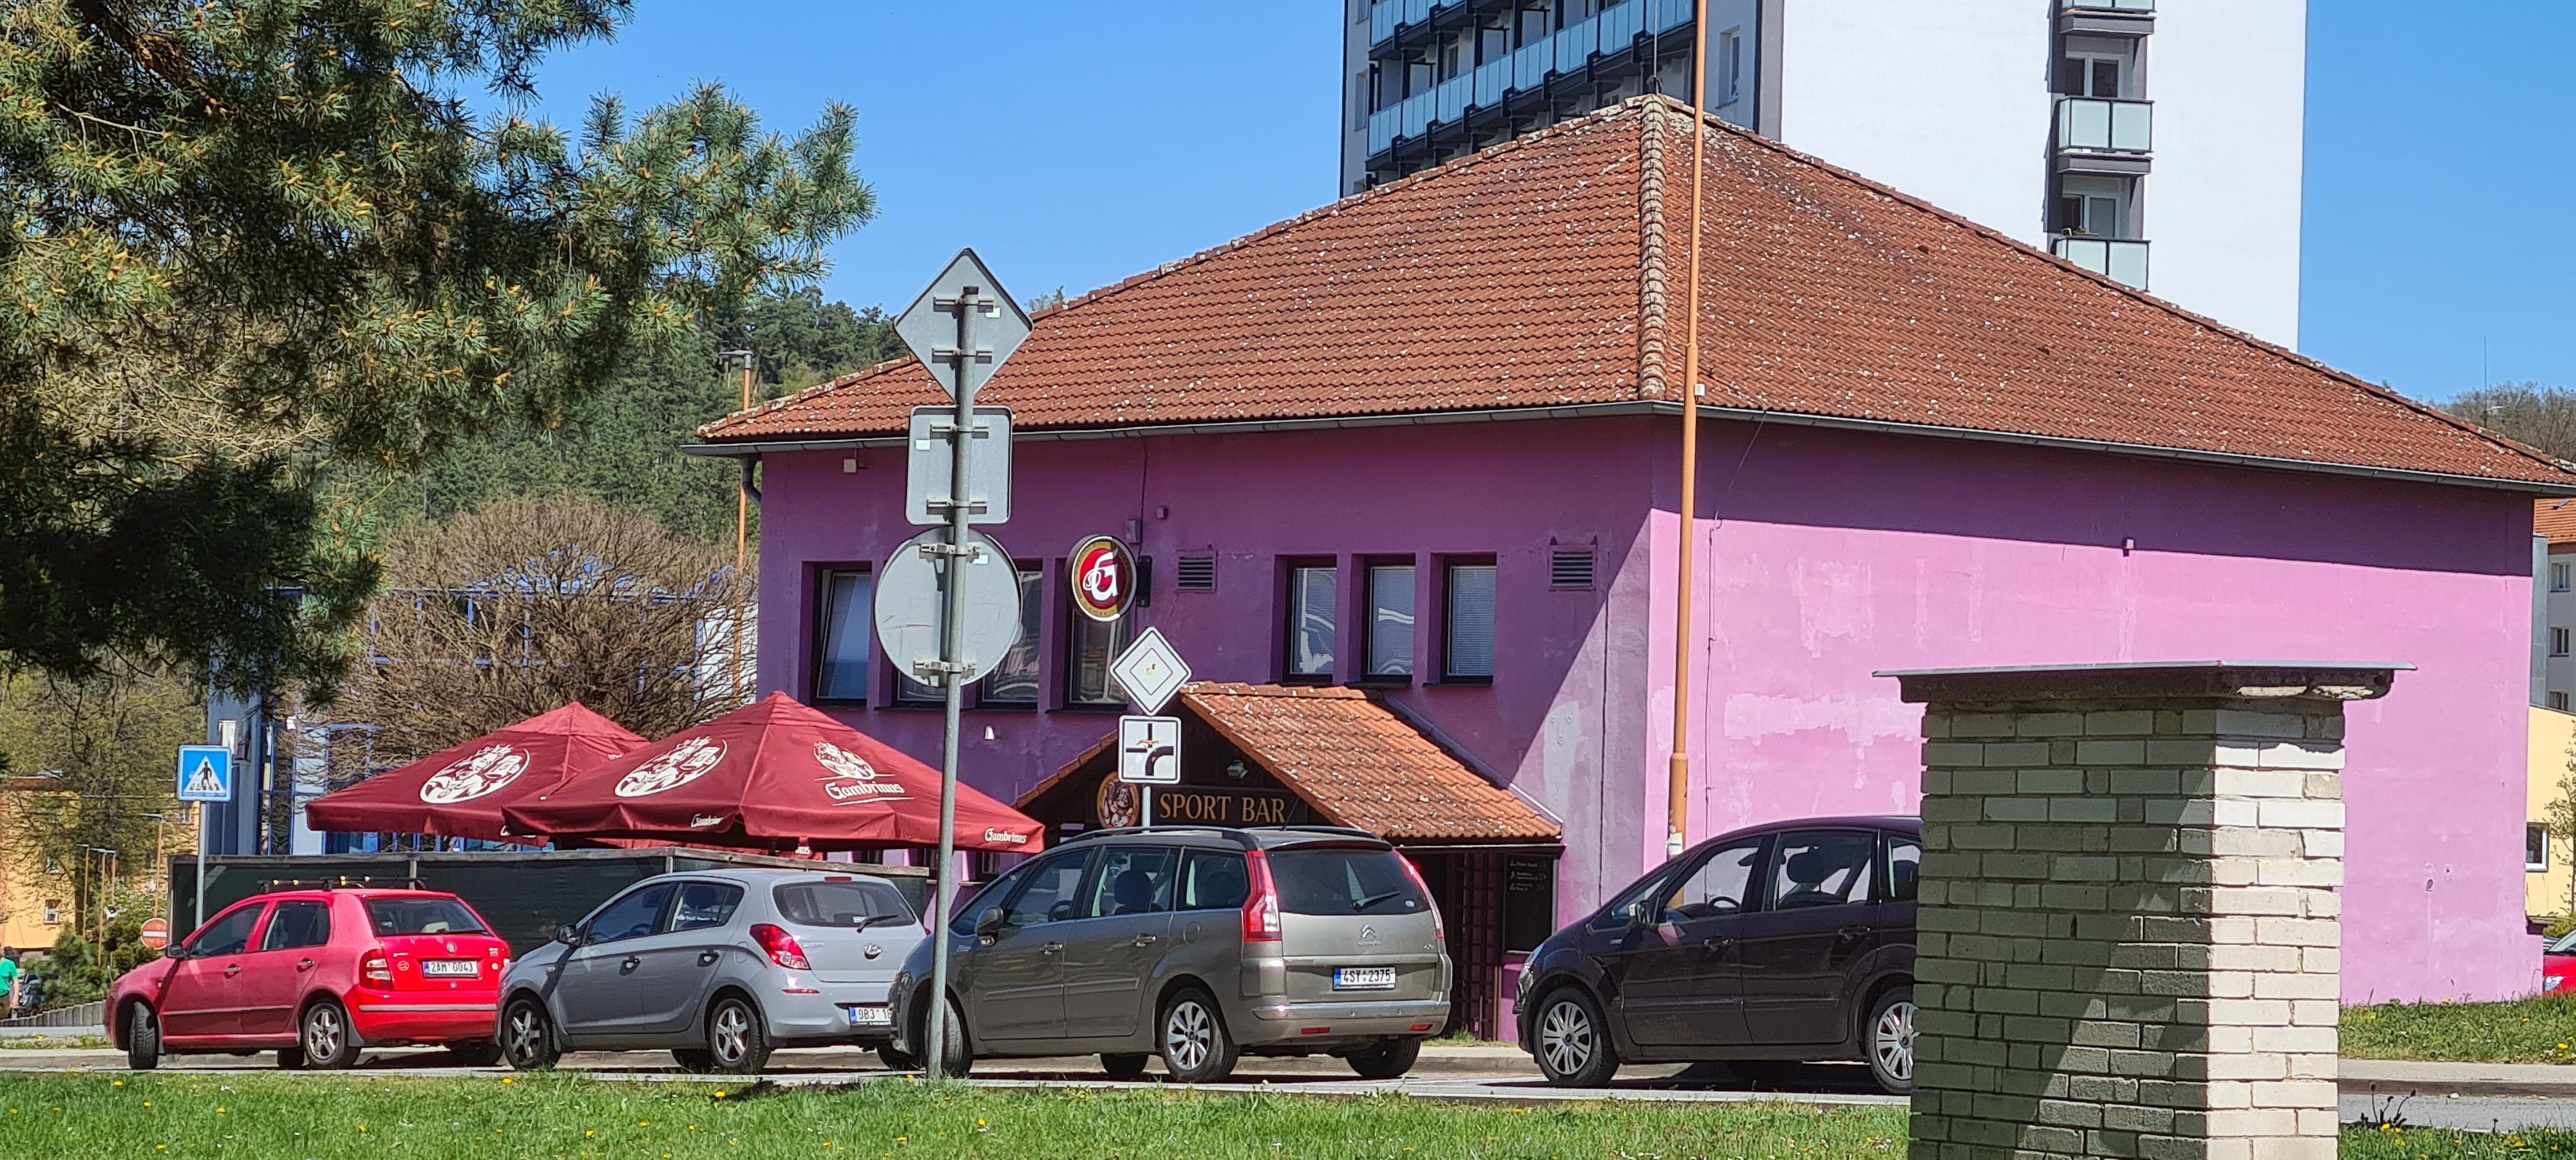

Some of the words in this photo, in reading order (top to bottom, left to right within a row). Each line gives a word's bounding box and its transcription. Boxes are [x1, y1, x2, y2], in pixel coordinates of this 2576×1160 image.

[825, 781, 905, 800] Gambrinus
[1159, 793, 1231, 821] SPORT
[1241, 797, 1285, 823] BAR
[984, 828, 1027, 844] Gambrinus
[453, 962, 473, 973] 0043
[1343, 969, 1361, 983] 4SY
[1368, 969, 1391, 982] 2375
